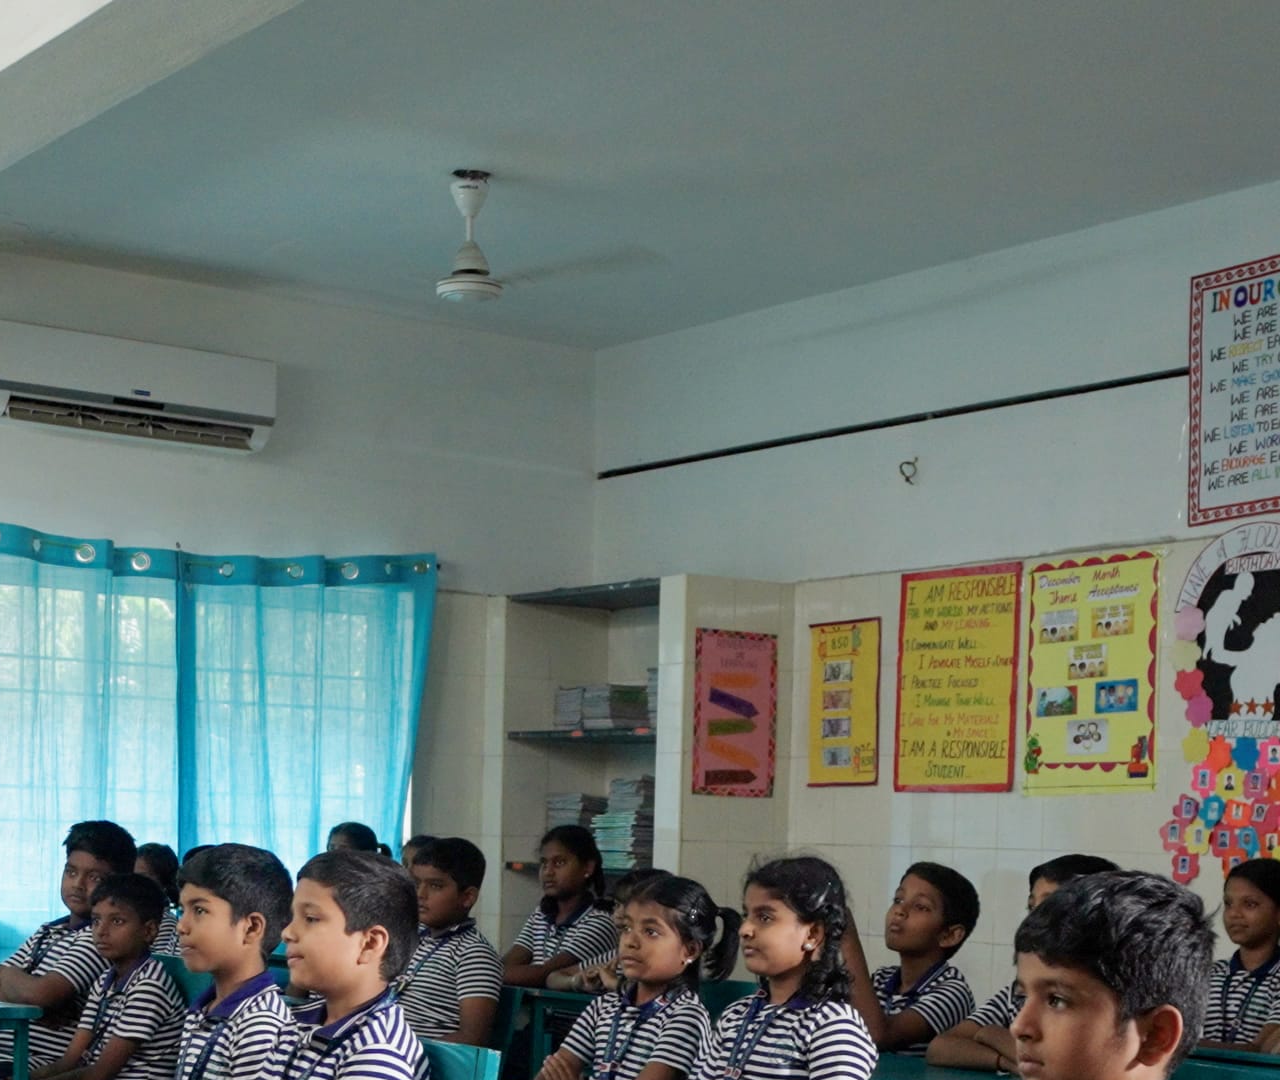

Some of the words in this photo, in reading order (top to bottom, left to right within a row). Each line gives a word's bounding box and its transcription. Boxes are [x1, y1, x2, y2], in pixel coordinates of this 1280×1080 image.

[1210, 289, 1232, 313] IN
[1233, 279, 1275, 309] OUR
[1232, 310, 1250, 326] WE
[1256, 304, 1278, 321] ARE
[1233, 326, 1250, 342] WE
[1256, 319, 1278, 335] ARE
[1210, 347, 1226, 362] WE
[1232, 359, 1249, 374] WE
[1256, 353, 1274, 369] TRY
[1210, 378, 1226, 394] WE
[1232, 373, 1257, 390] MAKE
[1231, 390, 1250, 406] WE
[1256, 384, 1280, 400] ARE
[1231, 408, 1248, 422] WE
[1254, 402, 1278, 417] ARE
[1204, 428, 1221, 444] WE
[1224, 422, 1255, 439] LISTEN
[1256, 420, 1270, 432] TO
[1229, 441, 1248, 456] WE
[1204, 460, 1220, 476] WE
[1208, 475, 1226, 492] WE
[1227, 471, 1249, 486] ARE
[1251, 467, 1270, 480] ALL
[1039, 573, 1080, 588] December
[1092, 567, 1120, 582] Month
[1182, 562, 1209, 607] HAVE
[908, 586, 915, 606] I
[926, 584, 945, 602] AM
[948, 574, 1015, 600] RESPONSIBLE
[1089, 584, 1139, 598] Acceptance
[900, 740, 908, 758] I
[911, 740, 925, 756] AM
[929, 739, 937, 755] A
[942, 739, 1006, 759] RESPONSIBLE
